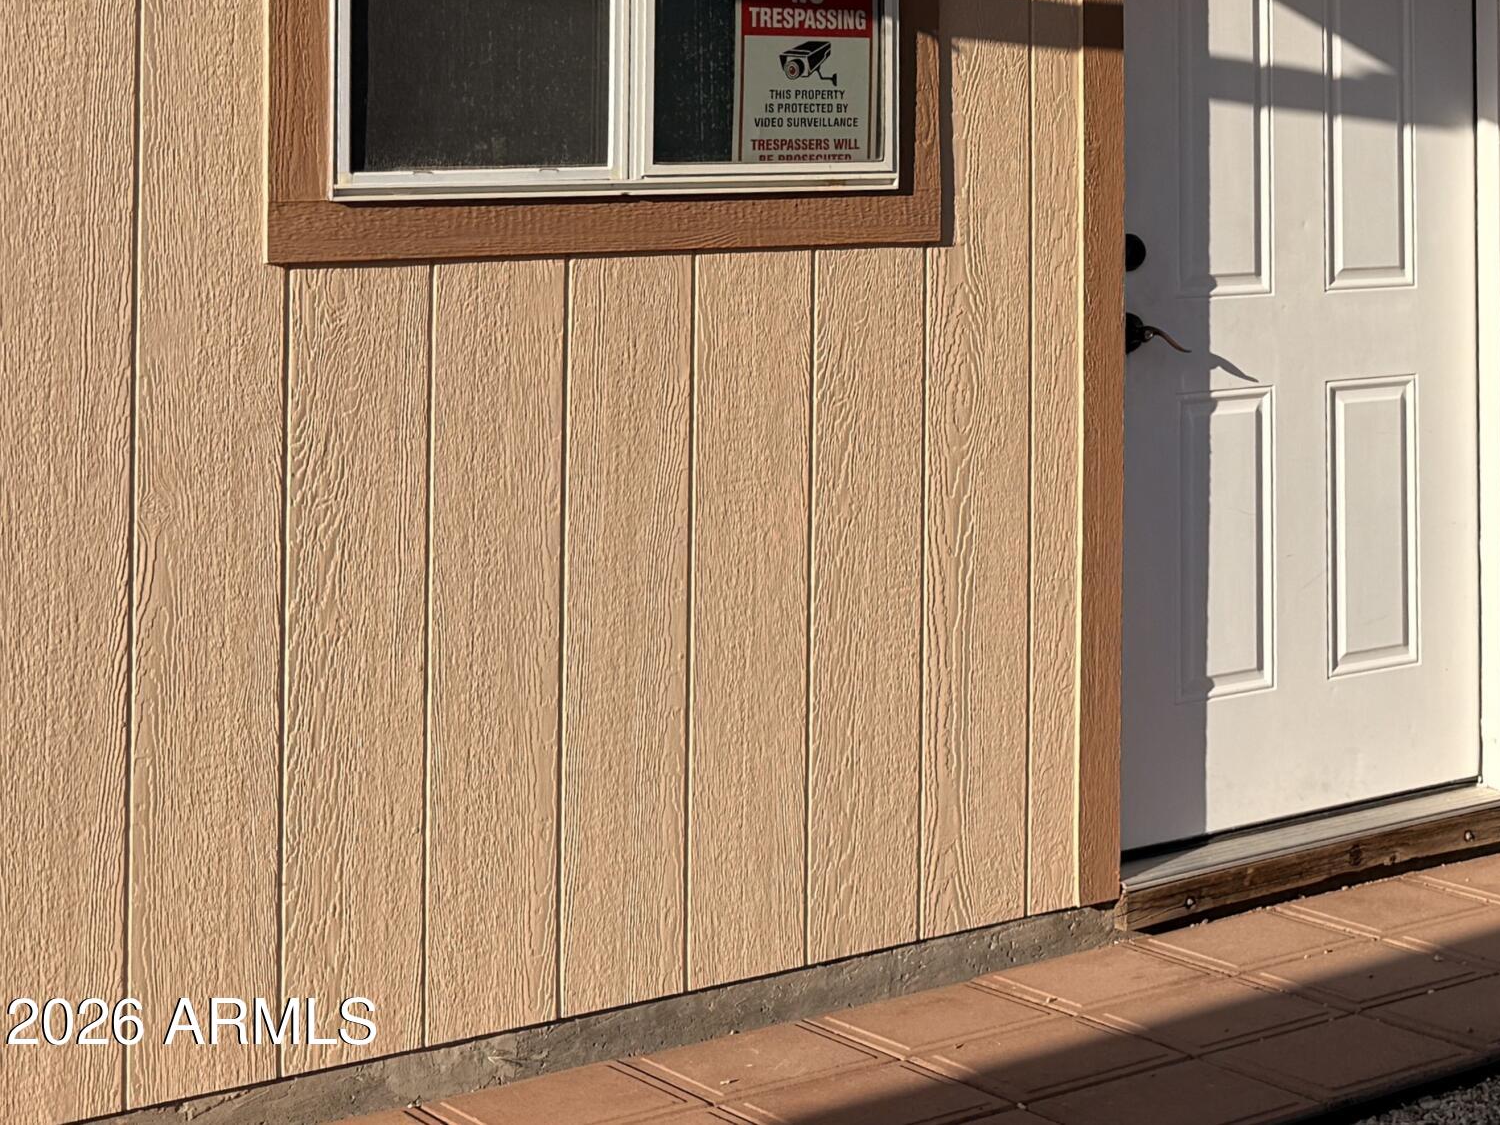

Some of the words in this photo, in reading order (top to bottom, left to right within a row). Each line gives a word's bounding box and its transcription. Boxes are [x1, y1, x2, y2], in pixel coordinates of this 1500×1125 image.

[749, 7, 867, 30] TRESPASSING
[769, 89, 791, 100] THIS
[795, 89, 845, 100] PROPERTY
[765, 103, 774, 113] IS
[777, 103, 833, 113] PROTECTED
[836, 103, 849, 113] BY
[754, 117, 784, 128] VIDEO
[786, 117, 859, 128] SURVEILLANCE
[750, 138, 830, 151] TRESPASSERS
[833, 138, 860, 150] WILL
